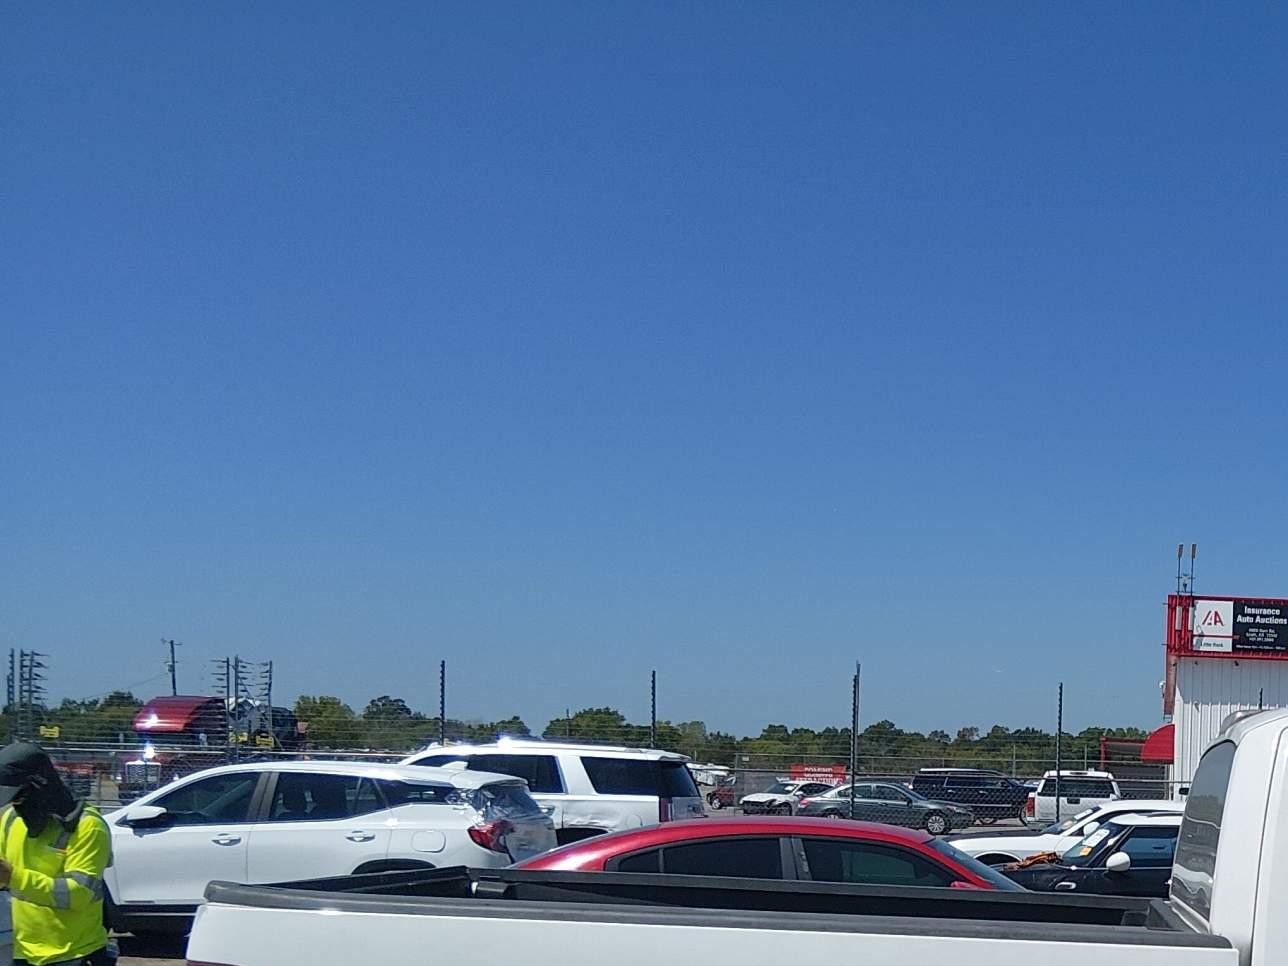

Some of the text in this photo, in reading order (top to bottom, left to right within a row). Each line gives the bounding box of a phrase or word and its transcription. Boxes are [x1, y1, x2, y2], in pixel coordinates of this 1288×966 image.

[1244, 605, 1280, 615] Insurance
[1236, 614, 1288, 625] Auto Auctions
